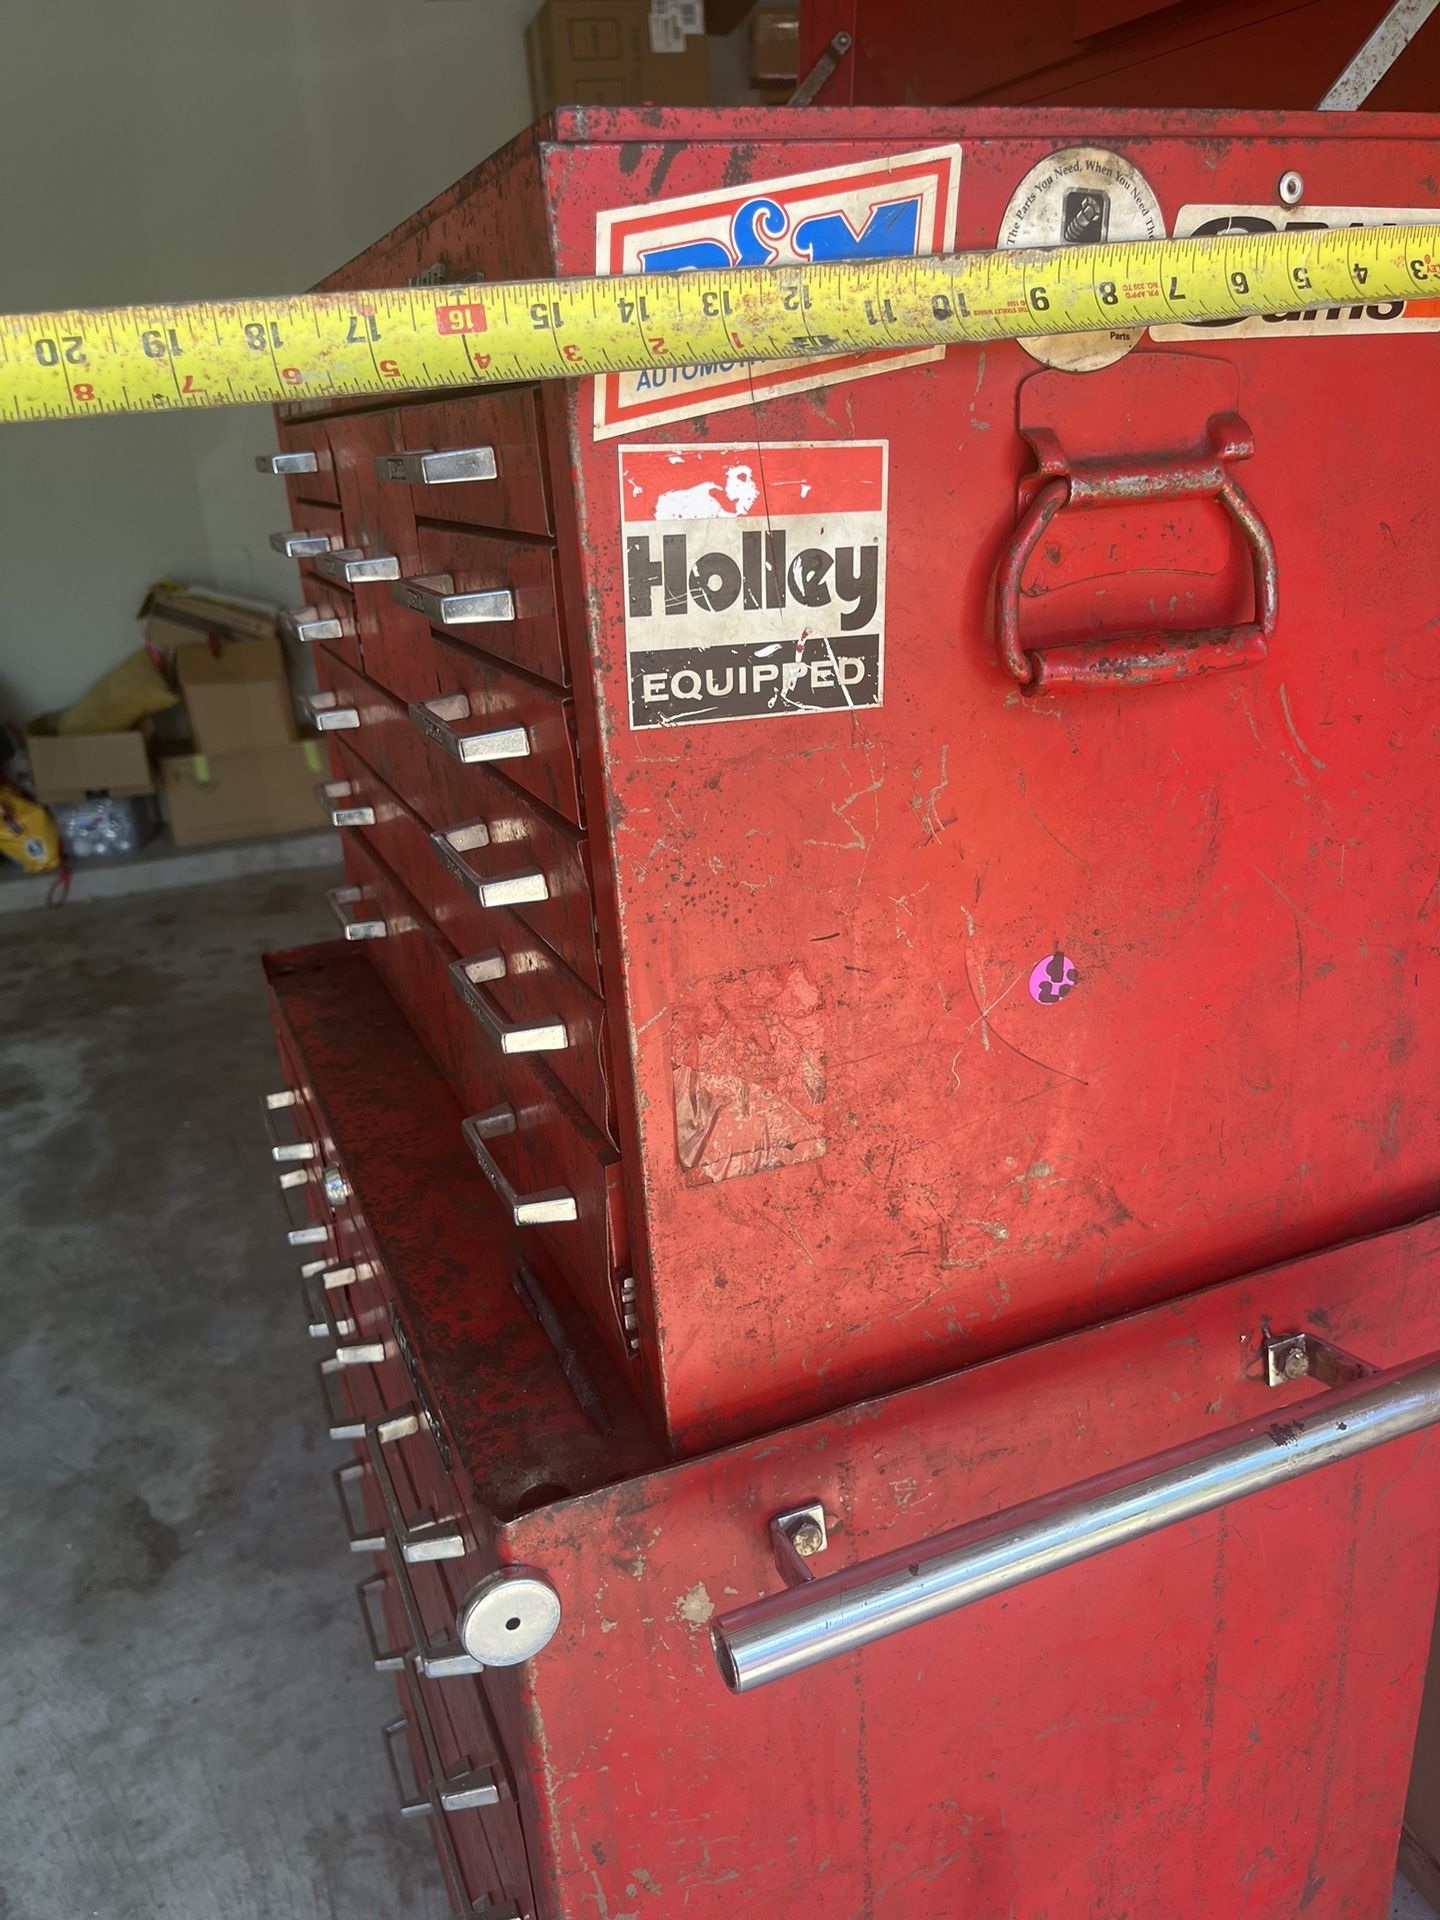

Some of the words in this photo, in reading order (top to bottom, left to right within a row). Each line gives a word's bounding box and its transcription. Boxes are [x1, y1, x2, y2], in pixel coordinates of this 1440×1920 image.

[1007, 221, 1021, 246] The
[1016, 193, 1036, 220] Parts
[1035, 175, 1054, 194] You
[1054, 161, 1083, 180] Need,
[1086, 160, 1113, 177] When
[1114, 170, 1132, 191] You
[1130, 187, 1149, 217] Need
[1293, 267, 1312, 289] 5
[1353, 262, 1368, 284] 4
[1410, 259, 1428, 280] 3
[1099, 281, 1119, 305] 8
[1168, 276, 1186, 300] 7
[1231, 271, 1250, 294] 6
[618, 296, 651, 323] 14
[702, 291, 733, 317] 13
[784, 285, 813, 311] 12
[931, 293, 970, 320] 10
[1030, 286, 1050, 311] 9
[450, 310, 474, 331] 16
[530, 302, 564, 330] 15
[865, 298, 898, 325] 11
[244, 321, 285, 350] 18
[346, 315, 382, 344] 17
[732, 332, 744, 349] 1
[1110, 331, 1130, 341] Parts
[34, 335, 87, 367] 20
[141, 328, 184, 358] 19
[563, 344, 583, 362] 3
[648, 337, 669, 355] 2
[380, 359, 401, 377] 5
[474, 352, 491, 369] 4
[182, 375, 206, 394] 7
[281, 367, 303, 385] 6
[73, 383, 95, 401] 8
[626, 529, 879, 631] Holley
[643, 657, 865, 702] EQUIPPED
